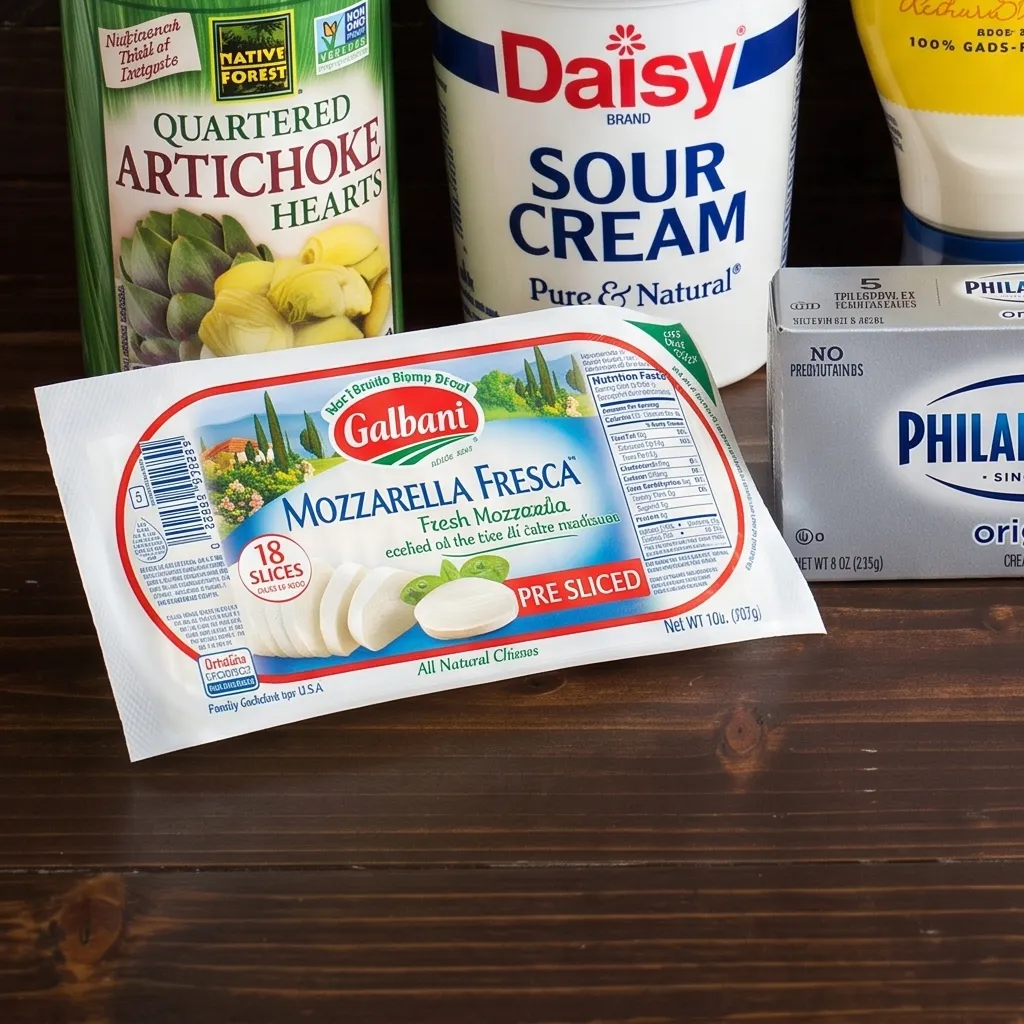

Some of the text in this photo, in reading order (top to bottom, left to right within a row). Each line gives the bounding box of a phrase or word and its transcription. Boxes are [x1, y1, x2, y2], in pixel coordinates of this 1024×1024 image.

[220, 46, 285, 65] NATIVE
[909, 36, 955, 51] 100%
[221, 66, 287, 85] FOREST
[500, 25, 737, 119] Daisy
[153, 94, 350, 148] QUARTERED
[606, 113, 651, 125] BRAND
[115, 116, 382, 198] ARTICHOKE
[529, 142, 725, 205] SOUR
[271, 168, 382, 231] HEARTS
[509, 190, 746, 263] CREAM
[529, 277, 592, 305] Pure
[637, 273, 733, 307] Natural
[861, 278, 882, 289] 5
[810, 346, 844, 362] NO
[344, 400, 469, 448] Galbani
[282, 459, 582, 531] MOZZARELLA FRESCA
[254, 540, 285, 566] 18
[814, 557, 828, 570] WT
[831, 557, 837, 570] 8
[840, 557, 851, 570] OZ
[249, 563, 304, 585] SLICES
[519, 580, 560, 608] PRE
[563, 569, 641, 601] SLICED
[664, 617, 685, 633] Net
[686, 614, 704, 629] WT
[417, 661, 435, 675] All
[440, 650, 490, 672] Natural
